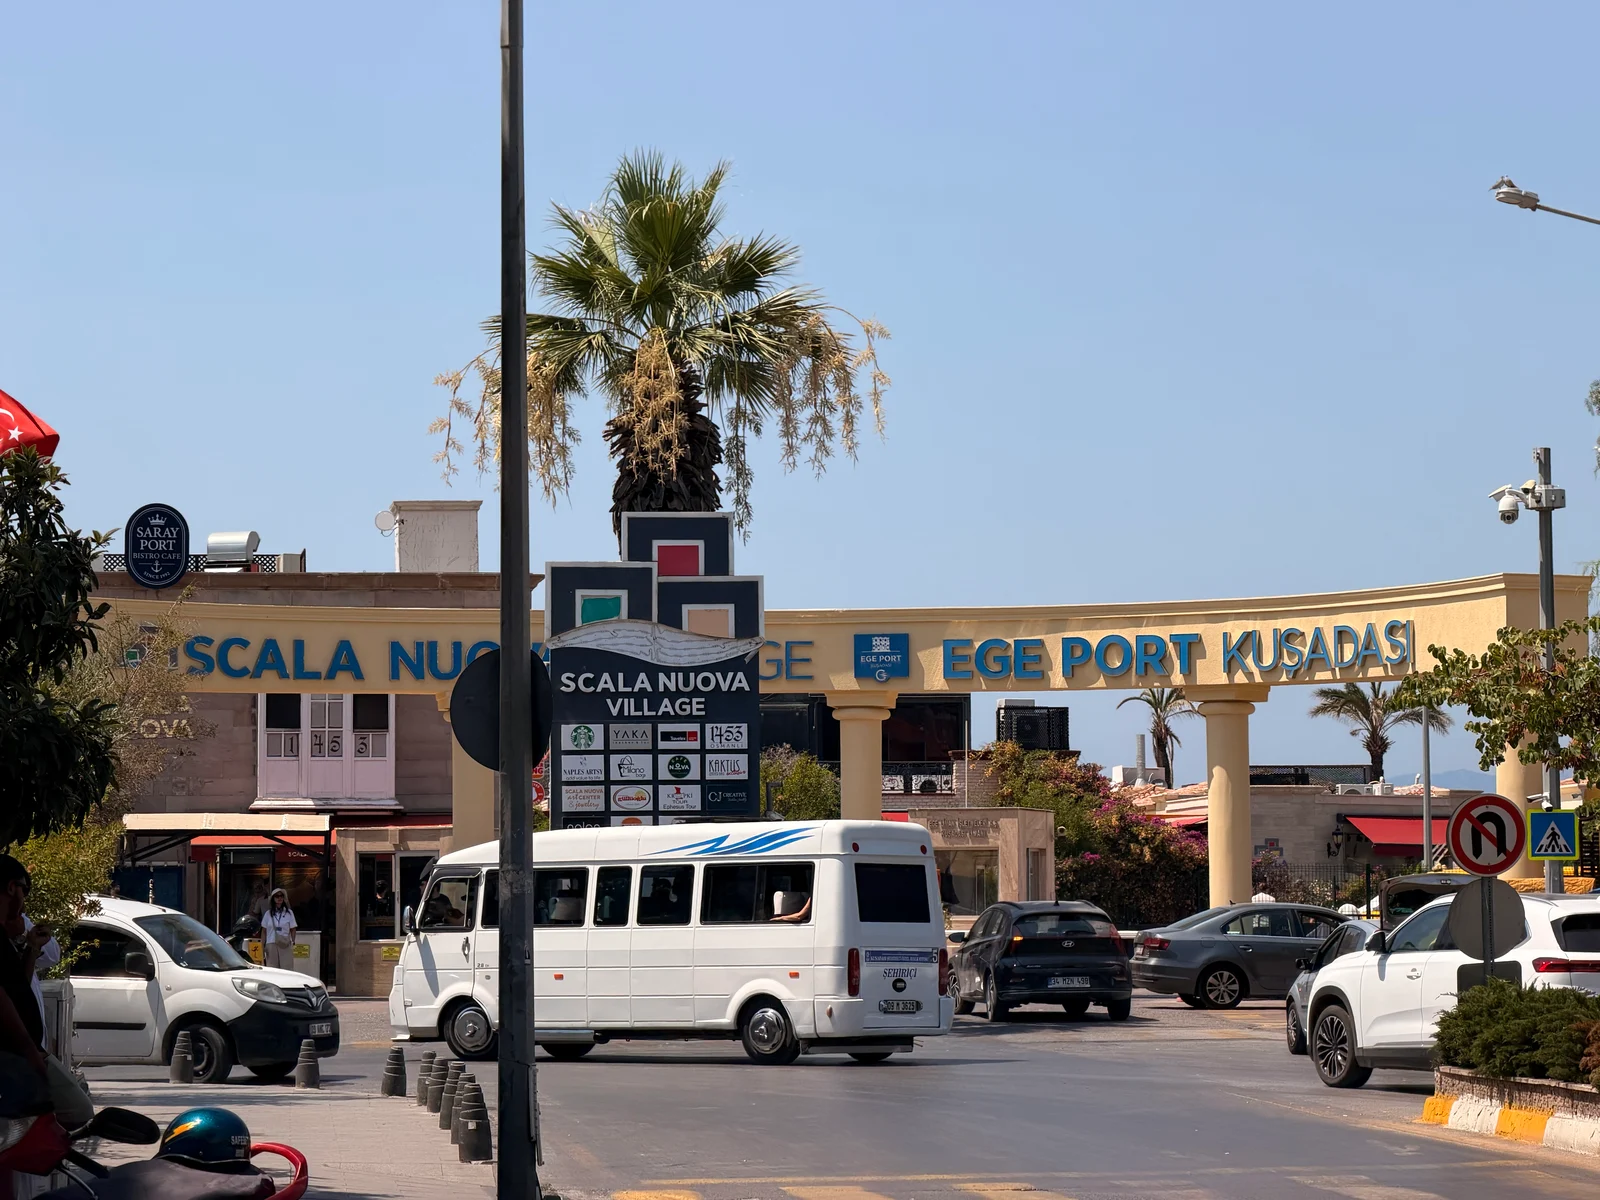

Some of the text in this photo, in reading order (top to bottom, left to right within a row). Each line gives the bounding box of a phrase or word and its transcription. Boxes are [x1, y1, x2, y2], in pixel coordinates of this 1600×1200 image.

[136, 526, 180, 538] SARAY
[139, 539, 177, 551] PORT
[132, 552, 182, 560] BISTRO CAFE
[143, 570, 160, 580] SINCE
[943, 619, 1414, 681] EGE PORT KUŞADASI
[183, 635, 365, 681] SCALA
[860, 654, 902, 663] EGE PORT
[559, 671, 751, 693] SCALA NUOVA
[606, 697, 706, 717] VILLAGE
[613, 729, 649, 739] YAKA
[709, 725, 743, 745] 1453
[622, 765, 645, 774] Milano
[708, 791, 722, 802] CJ
[932, 949, 938, 962] 5
[883, 967, 918, 979] ŞEHİRİÇİ
[1051, 977, 1060, 985] 34
[887, 1001, 895, 1011] 09
